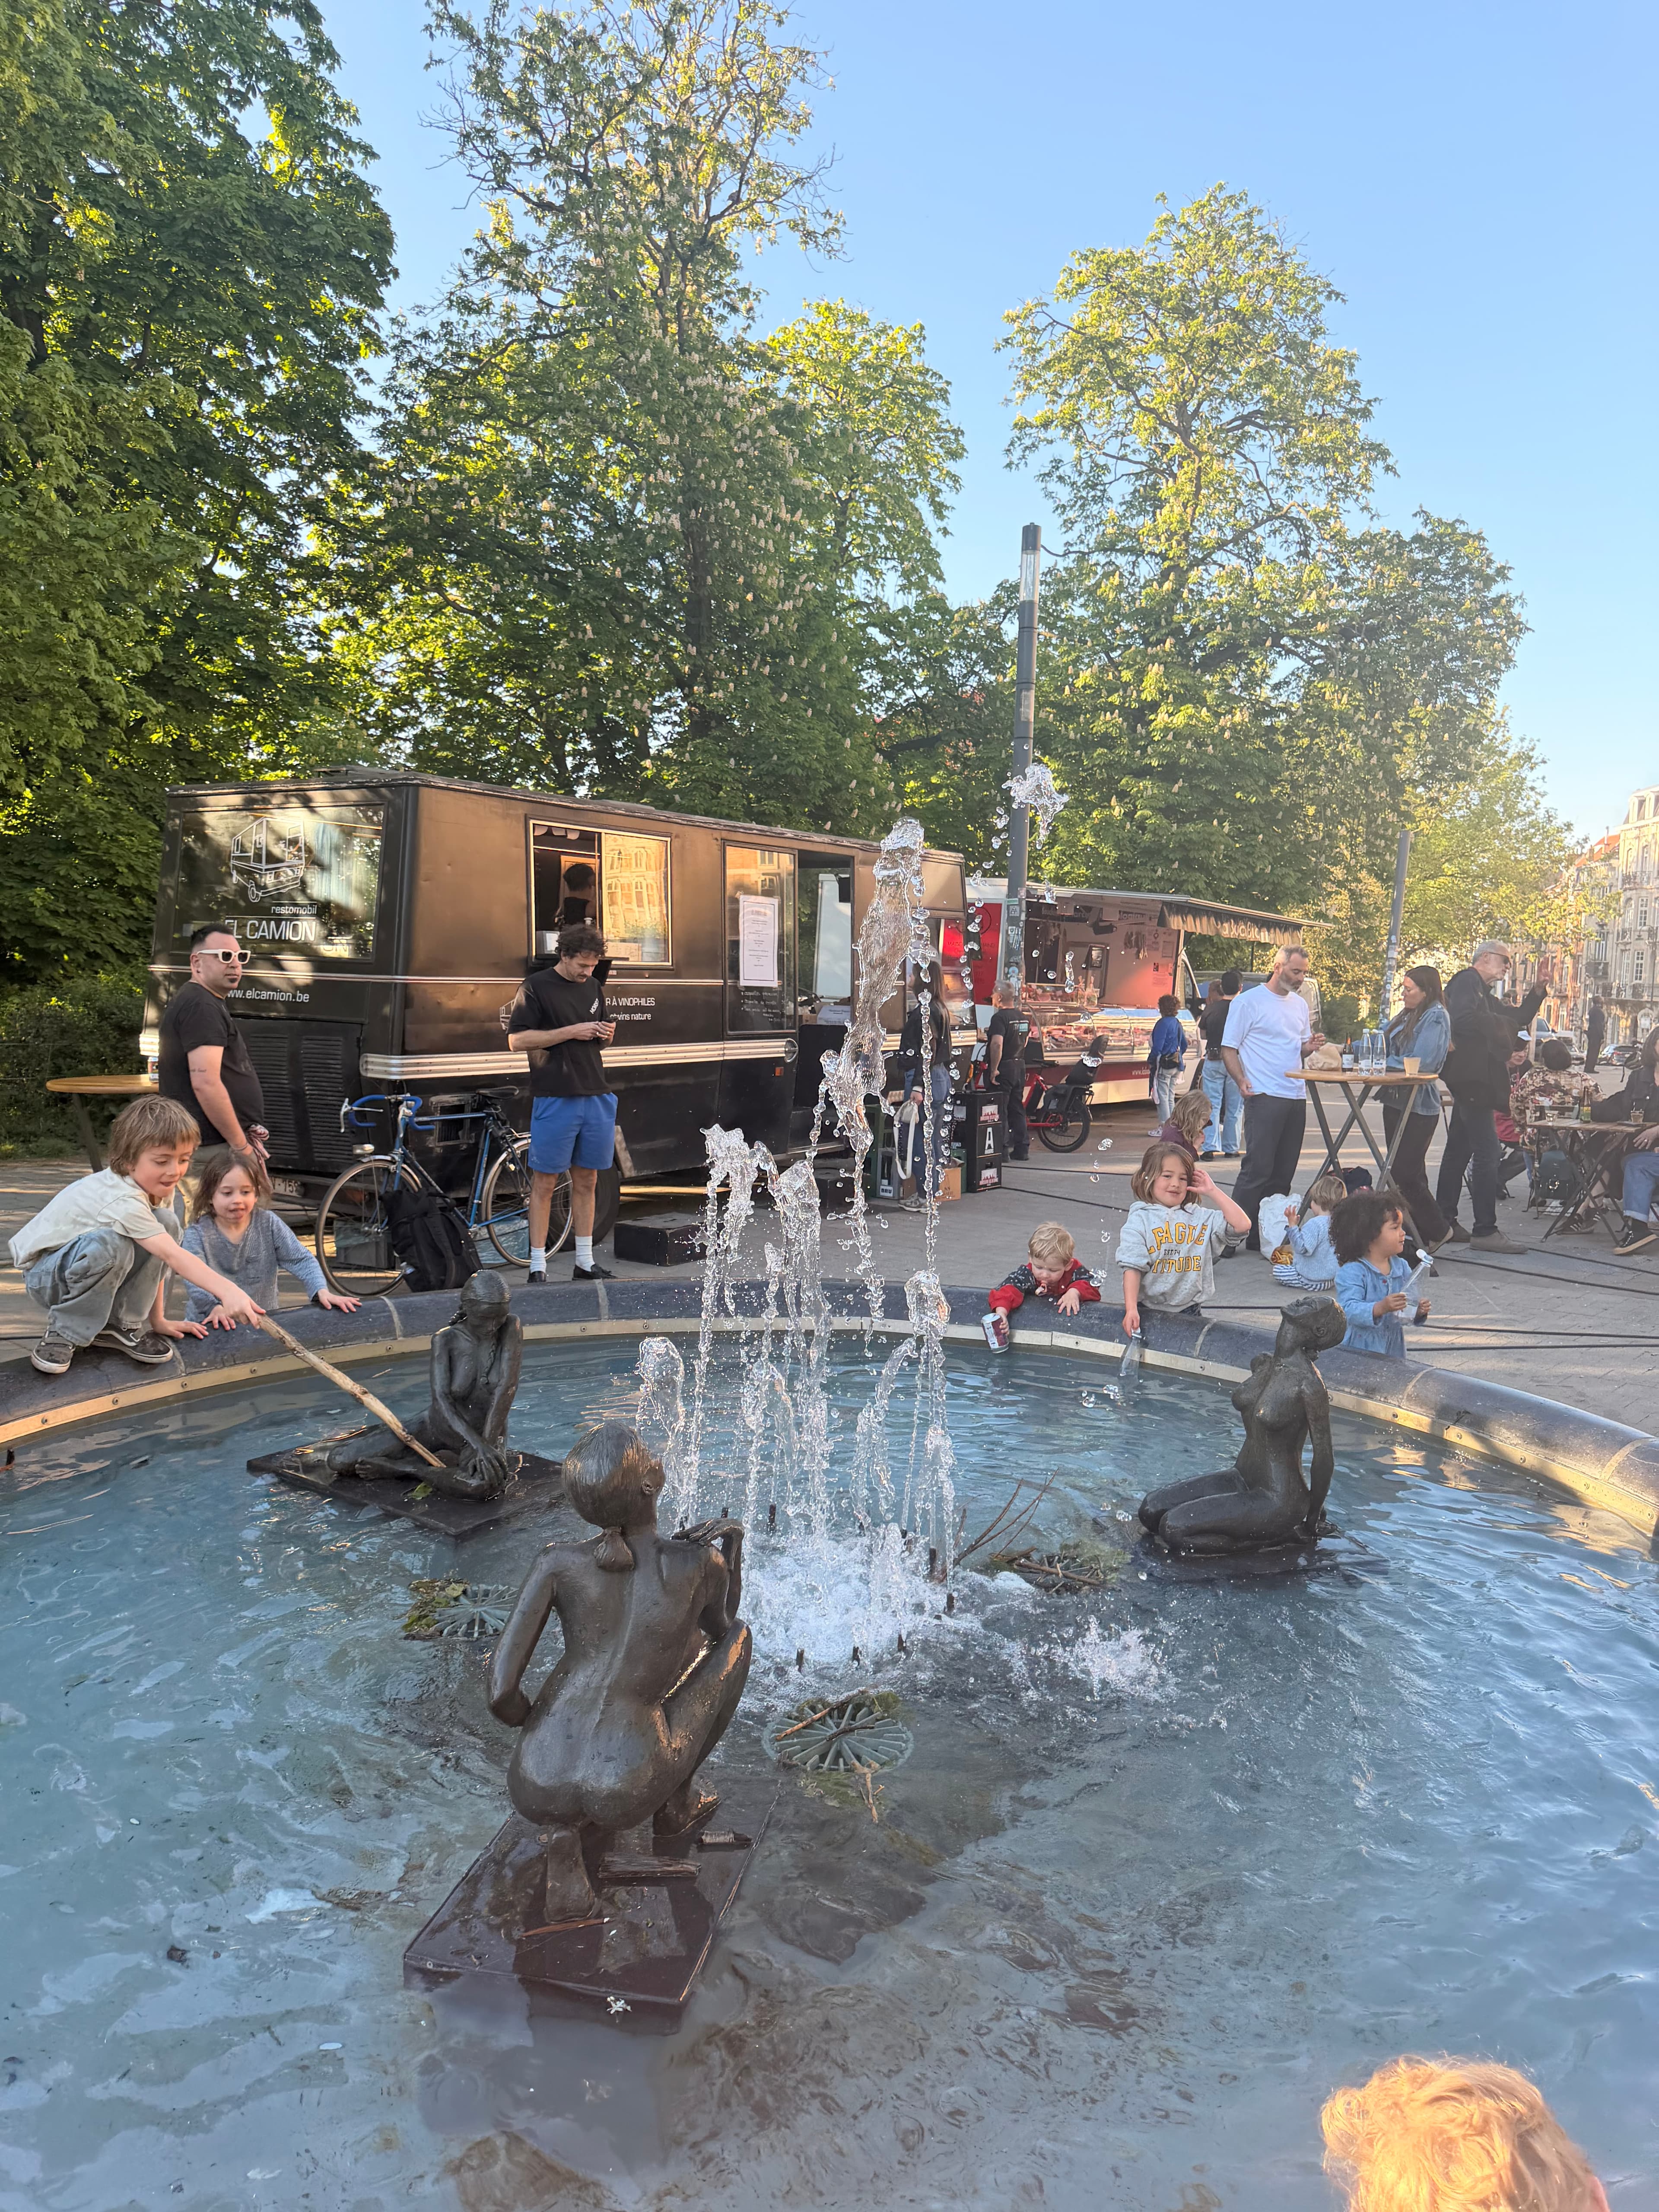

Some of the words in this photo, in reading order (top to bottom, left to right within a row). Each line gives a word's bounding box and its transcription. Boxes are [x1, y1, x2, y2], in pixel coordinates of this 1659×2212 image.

[271, 905, 317, 914] restomobil
[247, 920, 316, 941] CAMION
[227, 988, 310, 1002] ww.elcamion.be
[606, 998, 611, 1006] R
[612, 996, 617, 1006] À
[618, 998, 655, 1006] VINOPHILES
